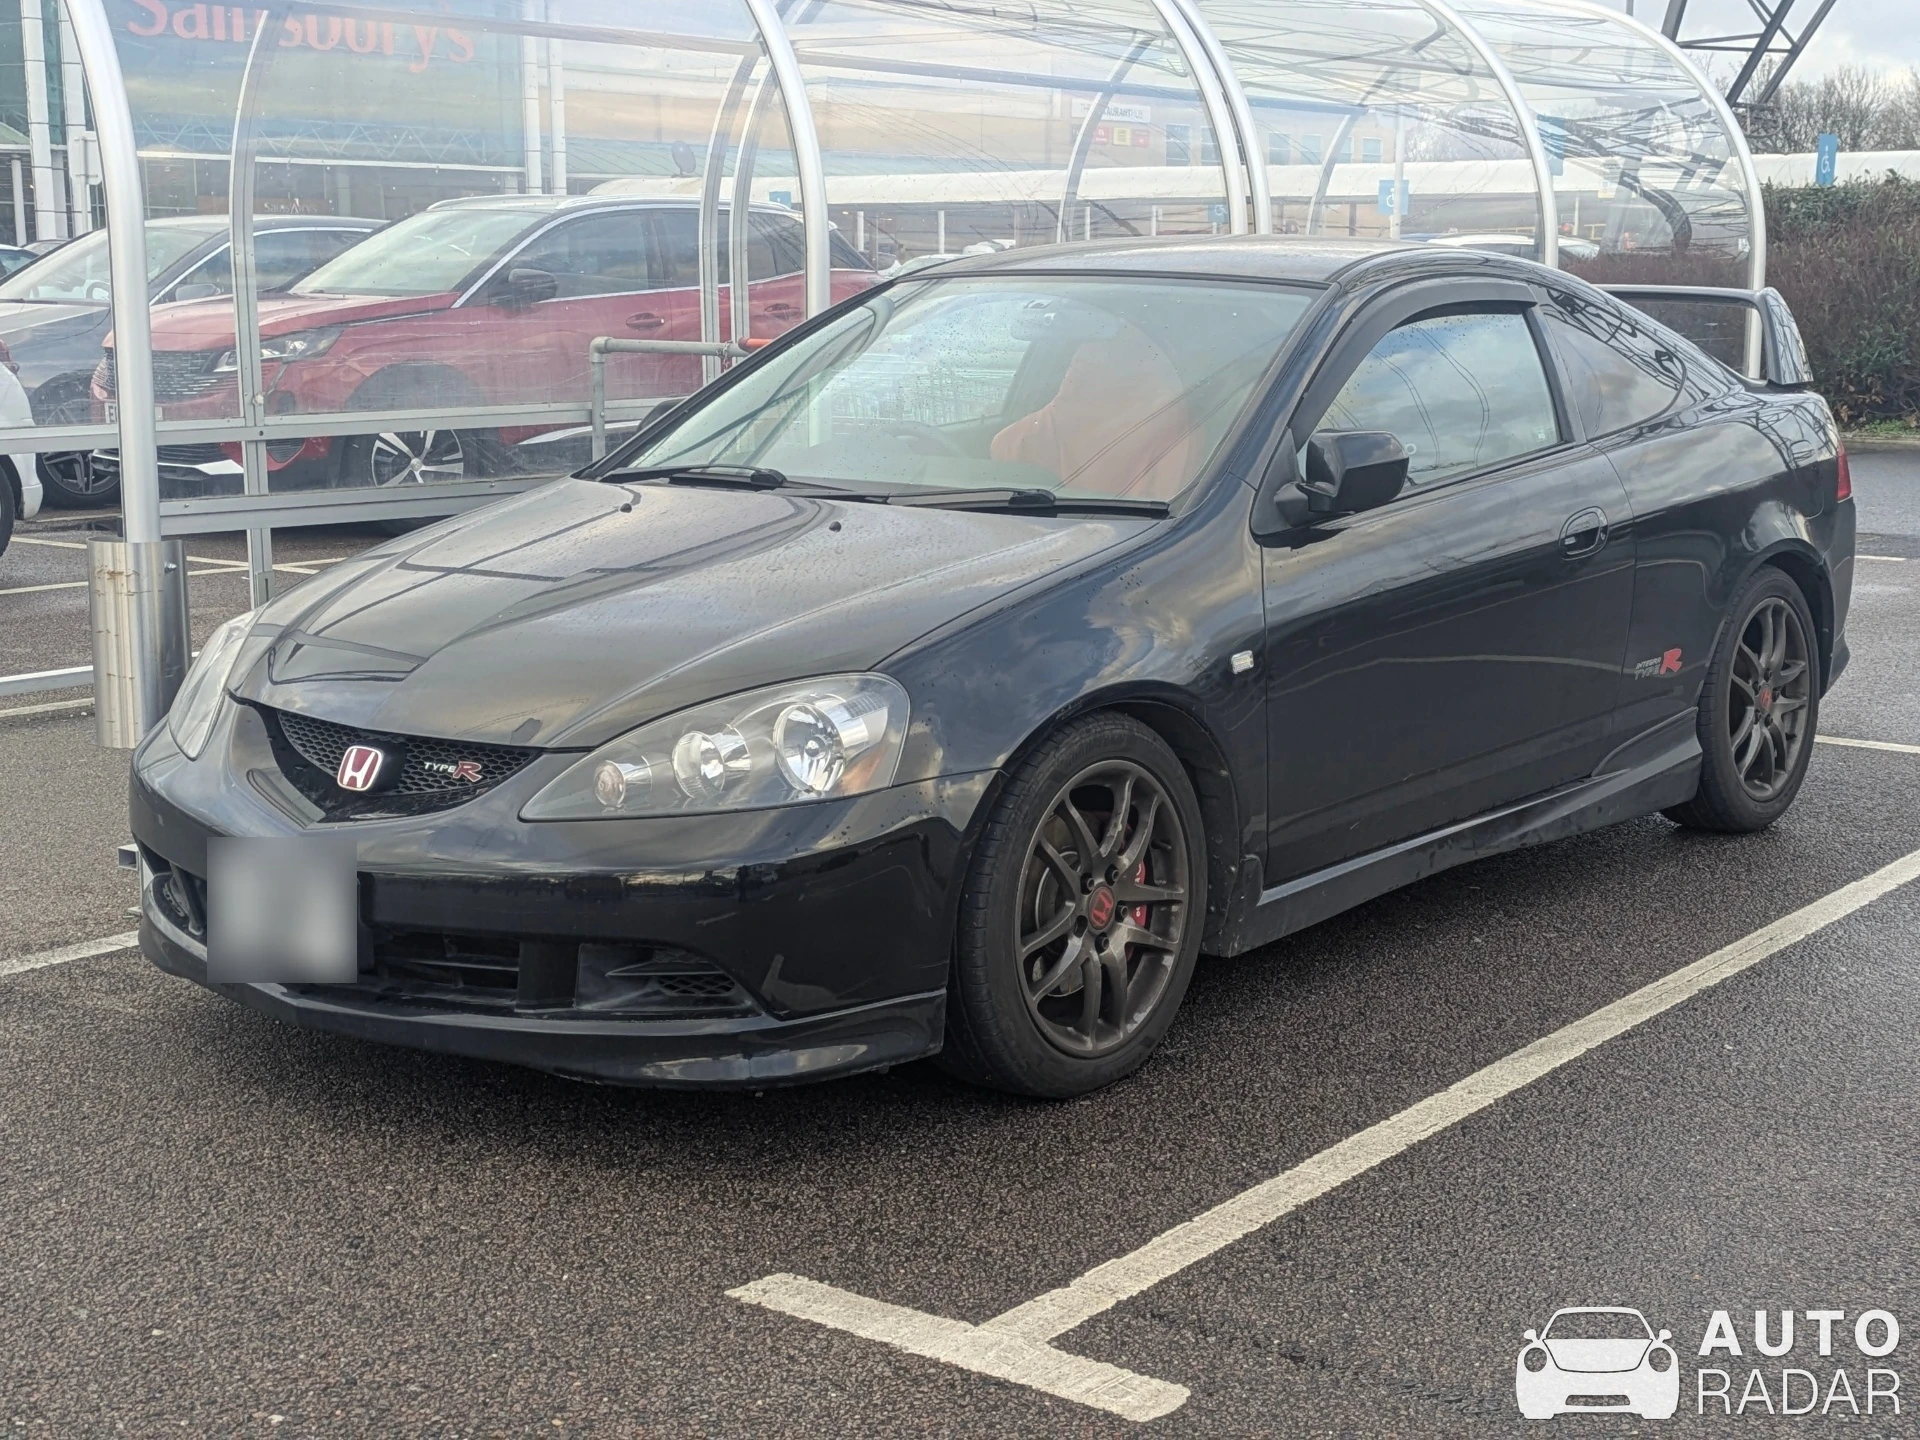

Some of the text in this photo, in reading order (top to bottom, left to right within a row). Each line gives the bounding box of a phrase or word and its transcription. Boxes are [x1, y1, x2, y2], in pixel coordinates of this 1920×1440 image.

[1634, 648, 1682, 680] TYPE R
[423, 761, 483, 783] TYPE R
